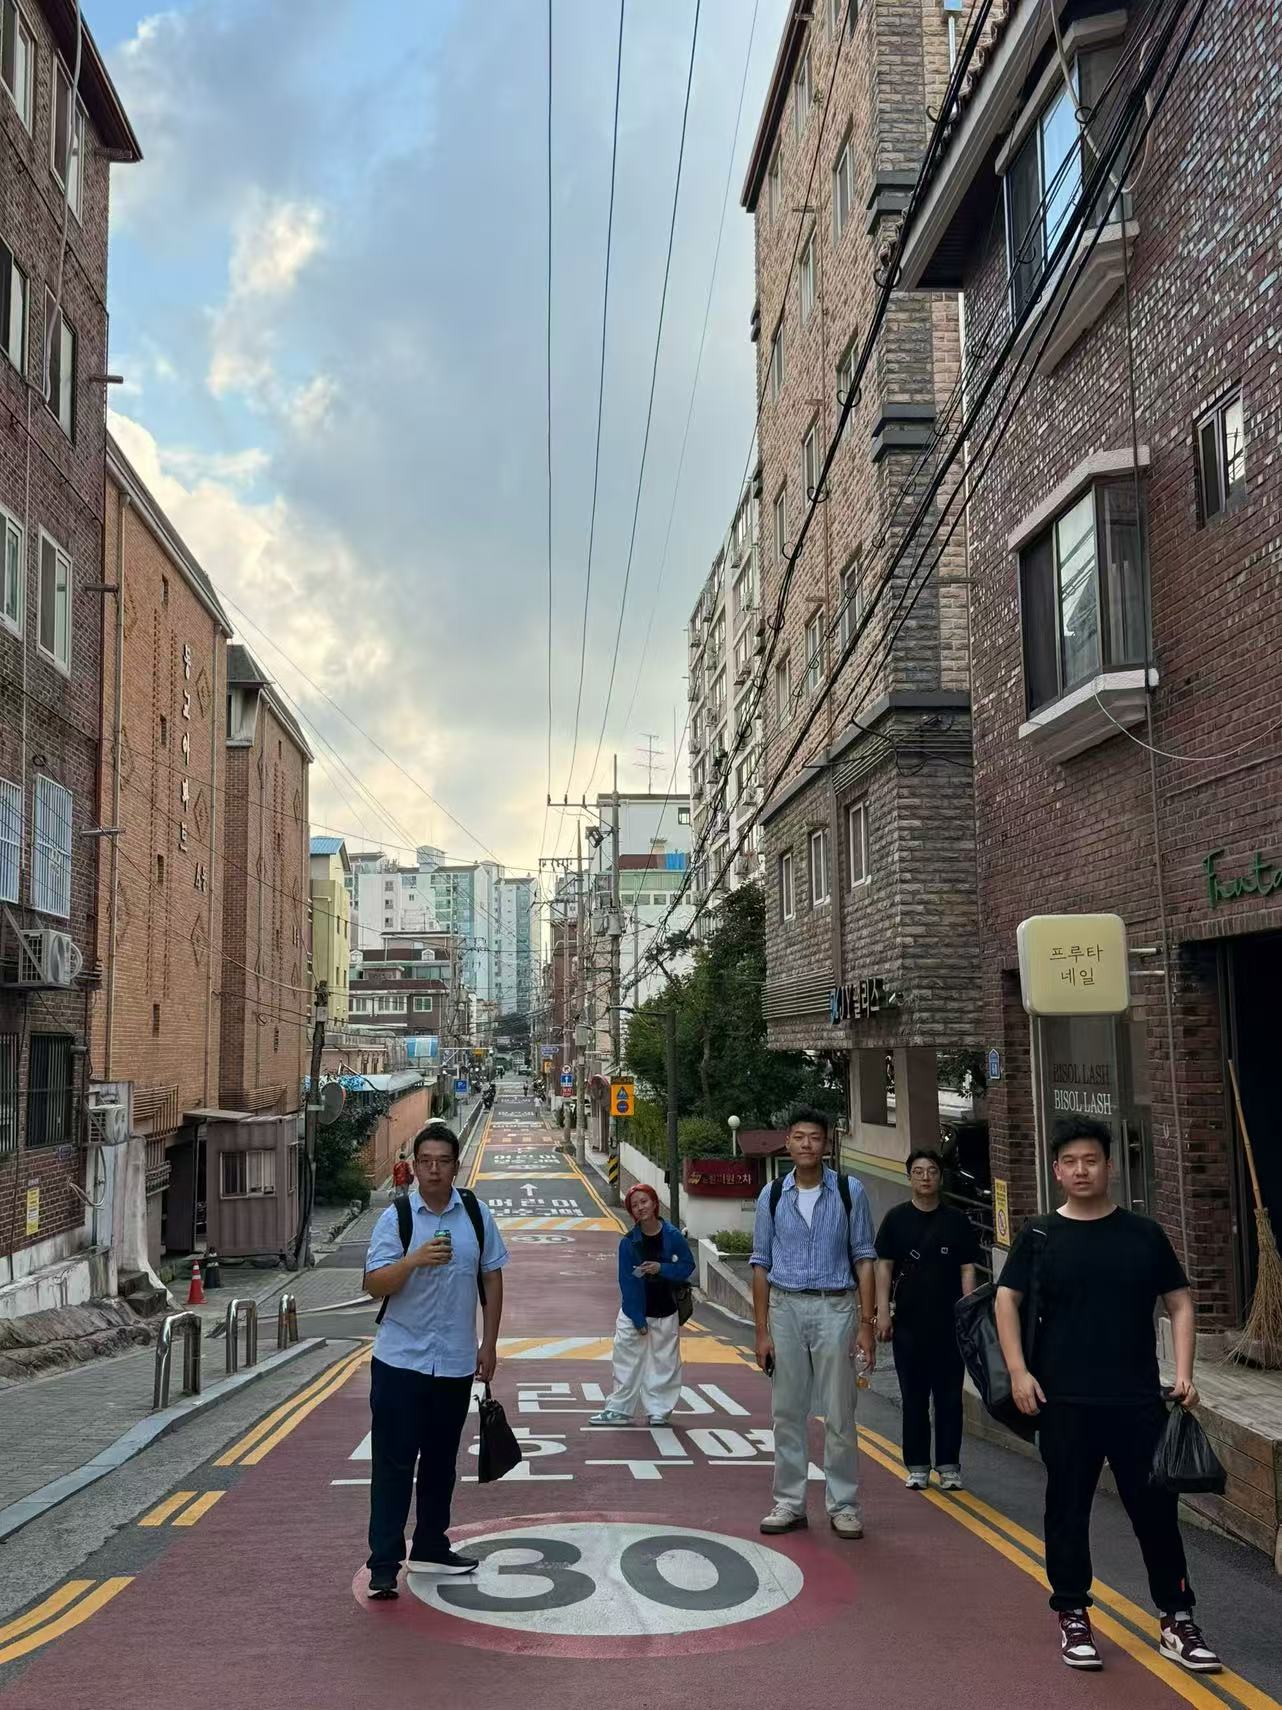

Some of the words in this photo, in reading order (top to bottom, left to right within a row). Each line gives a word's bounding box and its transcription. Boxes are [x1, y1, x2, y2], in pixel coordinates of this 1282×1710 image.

[1049, 943, 1104, 964] 프루타
[1061, 967, 1096, 987] 네일
[1054, 1089, 1082, 1112] BISOL
[1083, 1091, 1113, 1115] LASH
[518, 1235, 565, 1243] 30
[437, 1535, 760, 1612] 30
